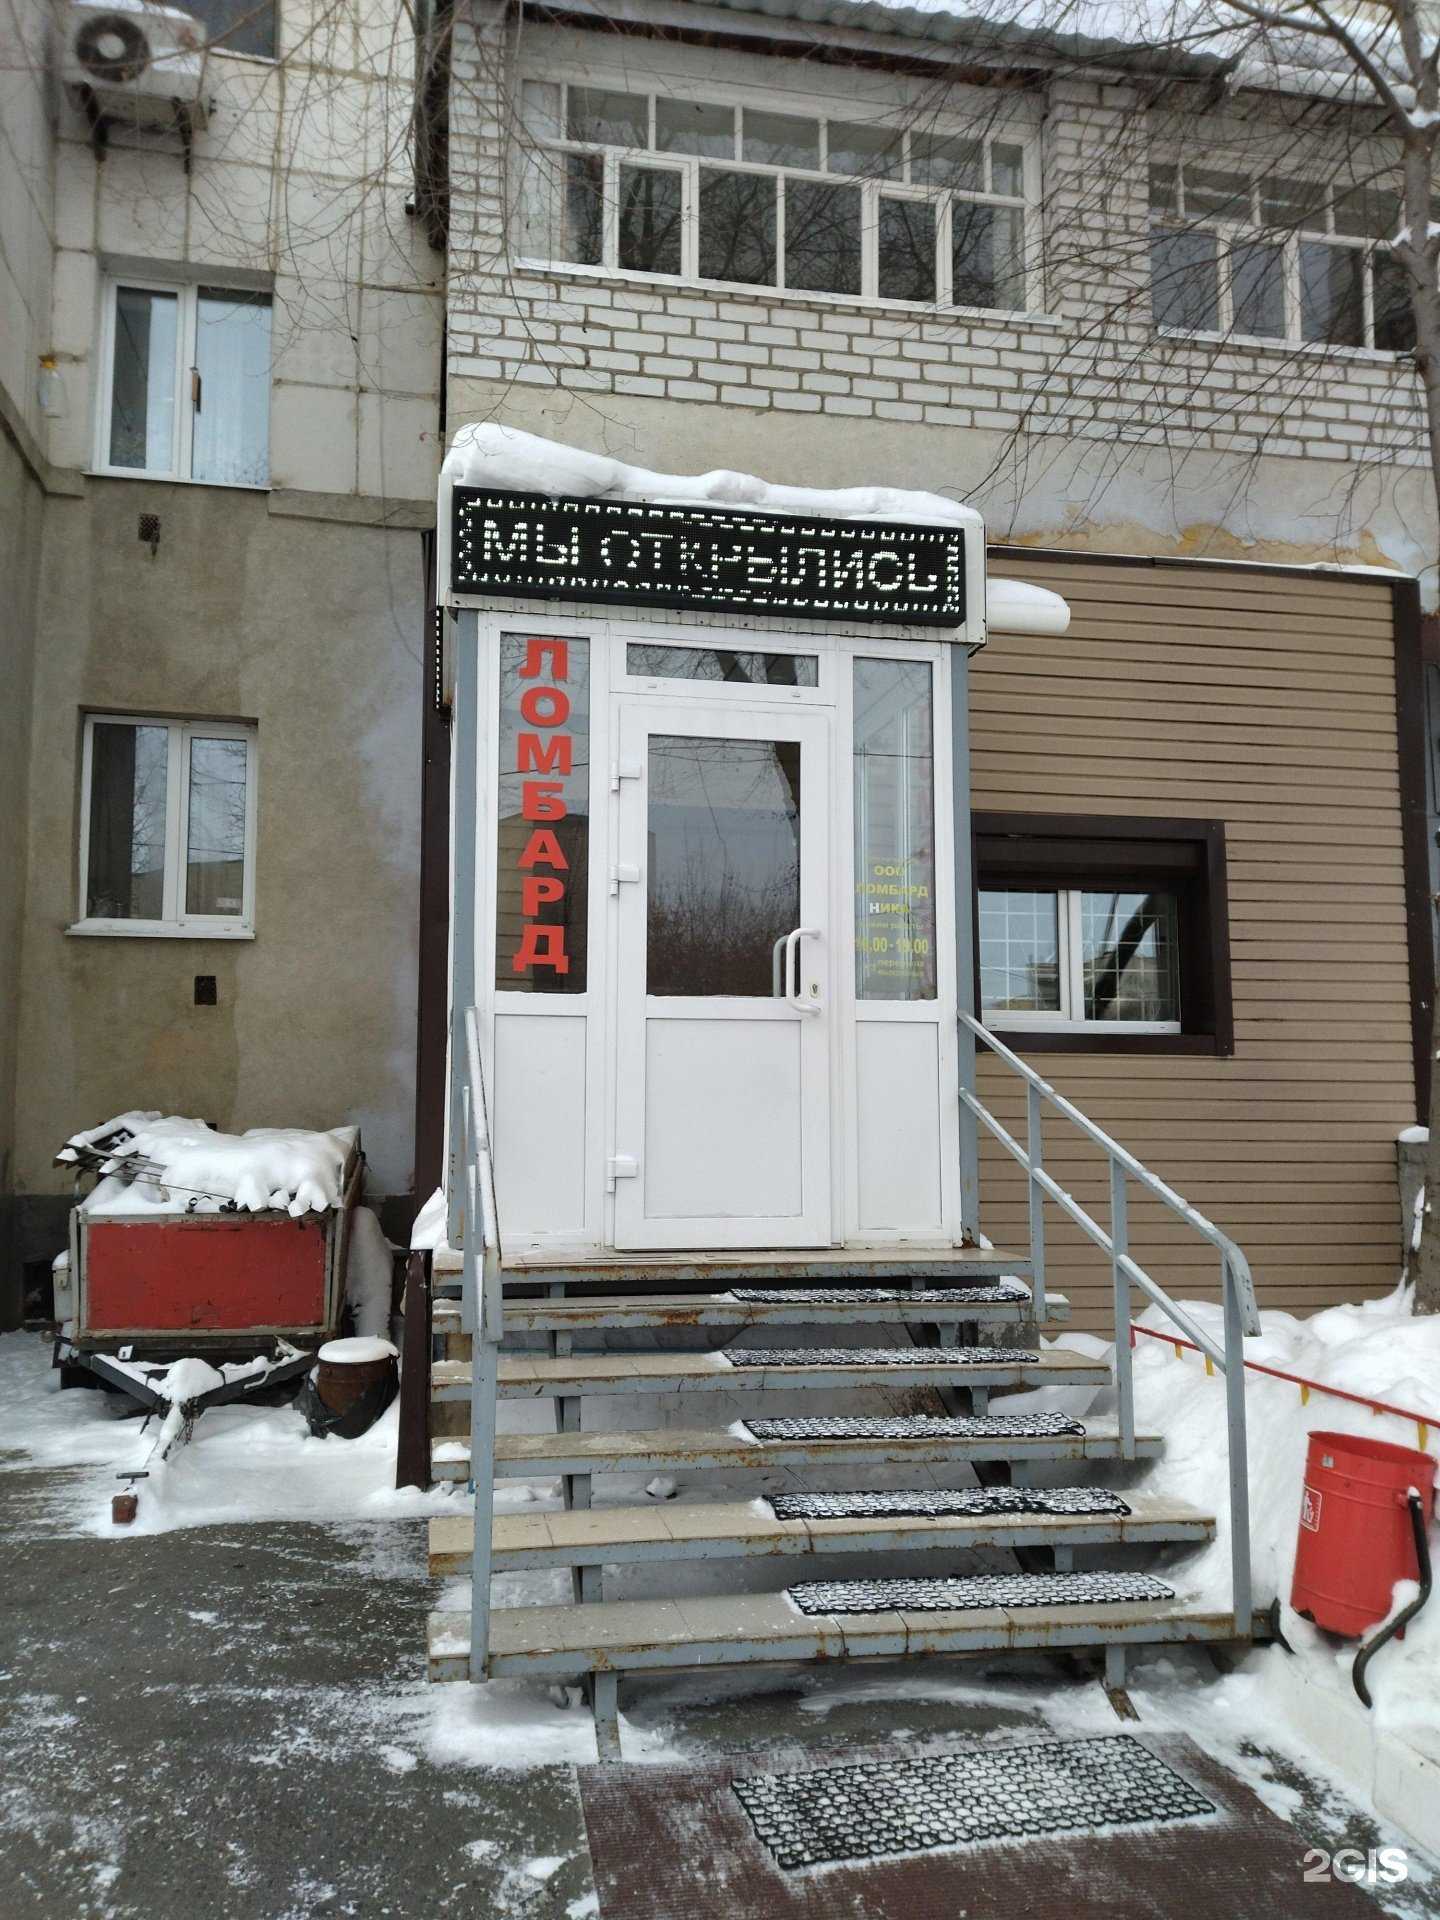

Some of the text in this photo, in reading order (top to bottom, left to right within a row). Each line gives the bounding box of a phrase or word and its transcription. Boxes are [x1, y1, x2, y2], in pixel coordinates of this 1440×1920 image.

[483, 519, 939, 592] МЫ ОТКРЫЛИСЬ
[512, 638, 573, 975] ЛОМБАРД
